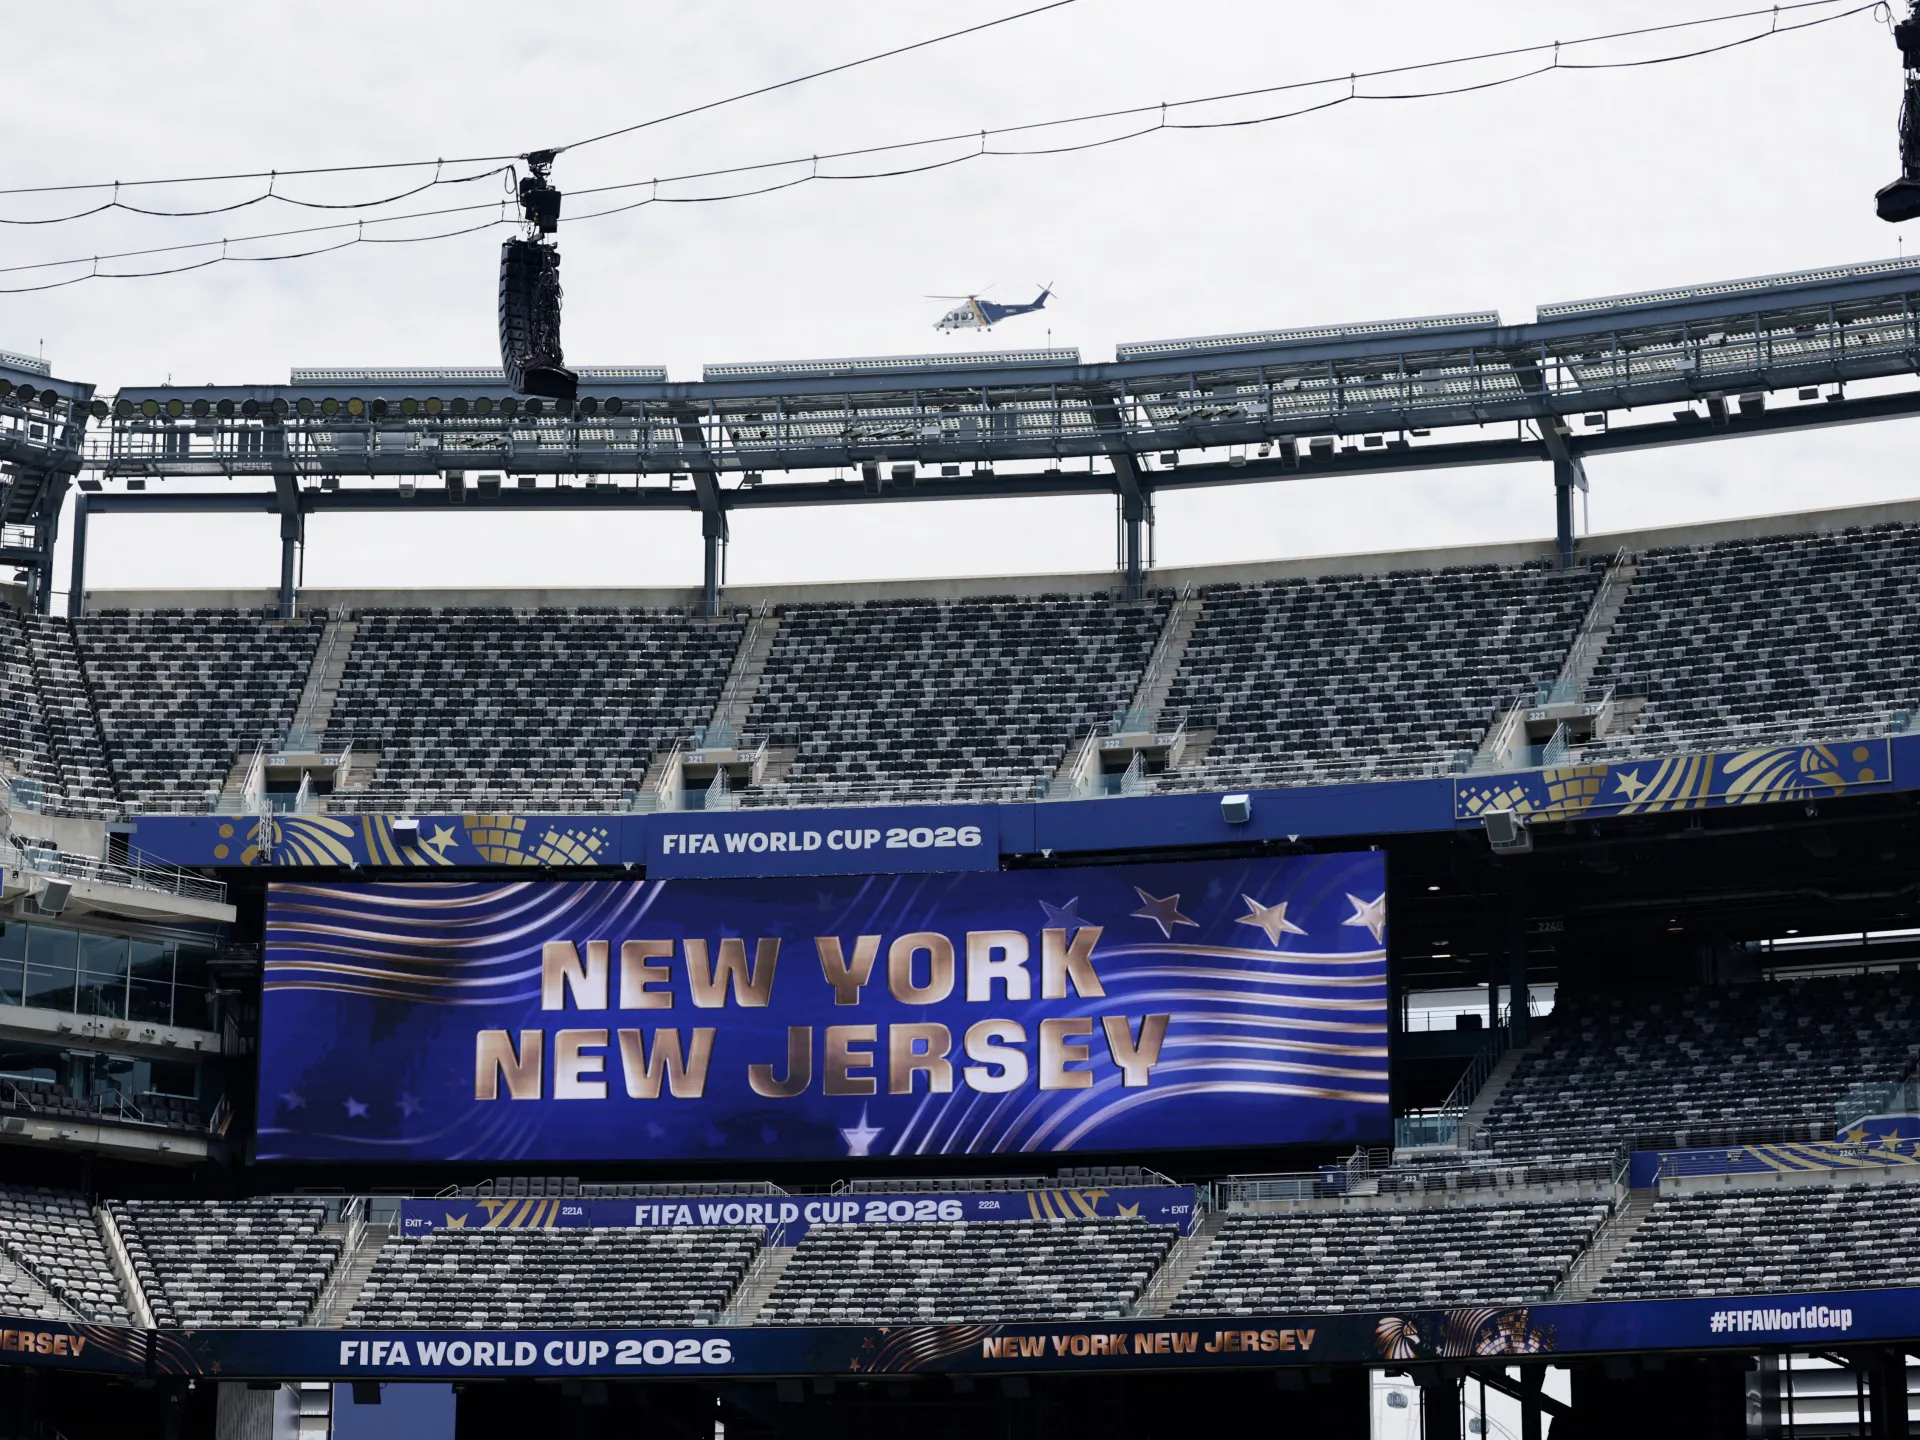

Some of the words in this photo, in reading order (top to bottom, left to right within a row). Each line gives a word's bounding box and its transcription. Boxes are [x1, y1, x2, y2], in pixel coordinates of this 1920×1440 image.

[1529, 711, 1546, 719] 323
[1104, 740, 1120, 748] 322
[324, 757, 339, 765] 321
[688, 755, 703, 763] 321
[662, 833, 720, 854] FIFA
[724, 831, 822, 853] WORLD
[826, 829, 881, 850] CUP
[886, 826, 982, 849] 2026
[541, 937, 782, 1011] NEW
[814, 925, 1106, 1005] YORK
[475, 1027, 716, 1101] NEW
[747, 1013, 1171, 1098] JERSEY
[562, 1207, 582, 1215] 221A
[635, 1205, 694, 1225] FIFA
[698, 1203, 799, 1225] WORLD
[804, 1202, 859, 1223] CUP
[865, 1200, 963, 1222] 2026
[978, 1201, 1000, 1209] 222A
[1171, 1205, 1189, 1214] EXIT
[405, 1219, 422, 1227] EXIT
[1710, 1306, 1853, 1332] #FIFAWorldCup
[0, 1329, 87, 1357] ERSEY
[983, 1336, 1046, 1358] NEW
[1051, 1333, 1129, 1356] YORK
[1134, 1332, 1199, 1355] NEW
[1204, 1329, 1316, 1353] JERSEY
[340, 1341, 411, 1366] FIFA
[416, 1341, 537, 1366] WORLD
[543, 1340, 609, 1366] CUP
[615, 1338, 731, 1365] 2026
